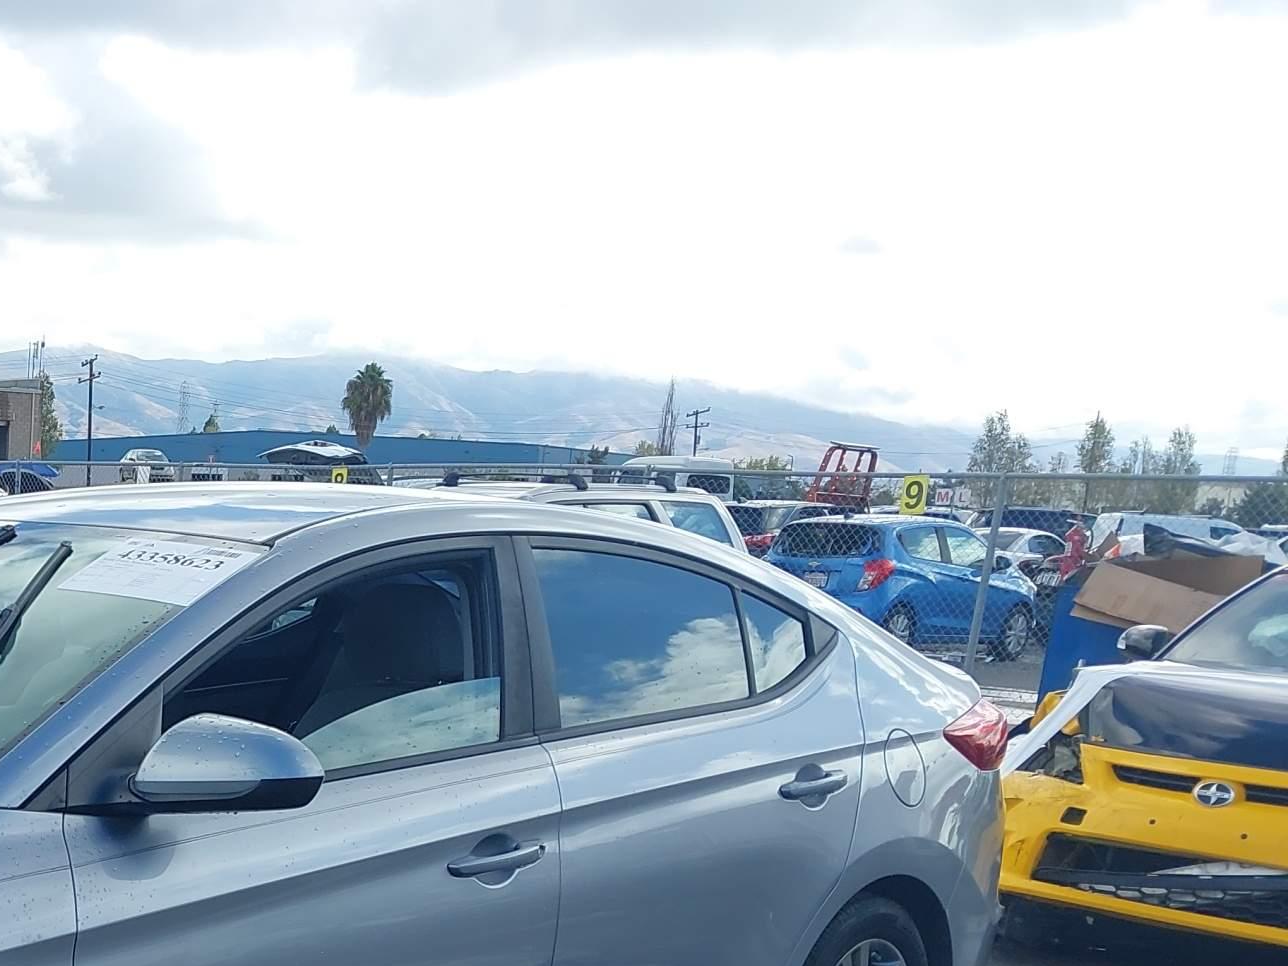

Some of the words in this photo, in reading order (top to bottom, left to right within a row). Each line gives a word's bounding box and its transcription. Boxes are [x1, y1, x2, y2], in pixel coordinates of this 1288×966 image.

[904, 480, 924, 509] 9
[936, 491, 949, 503] M
[117, 549, 225, 570] 43358623
